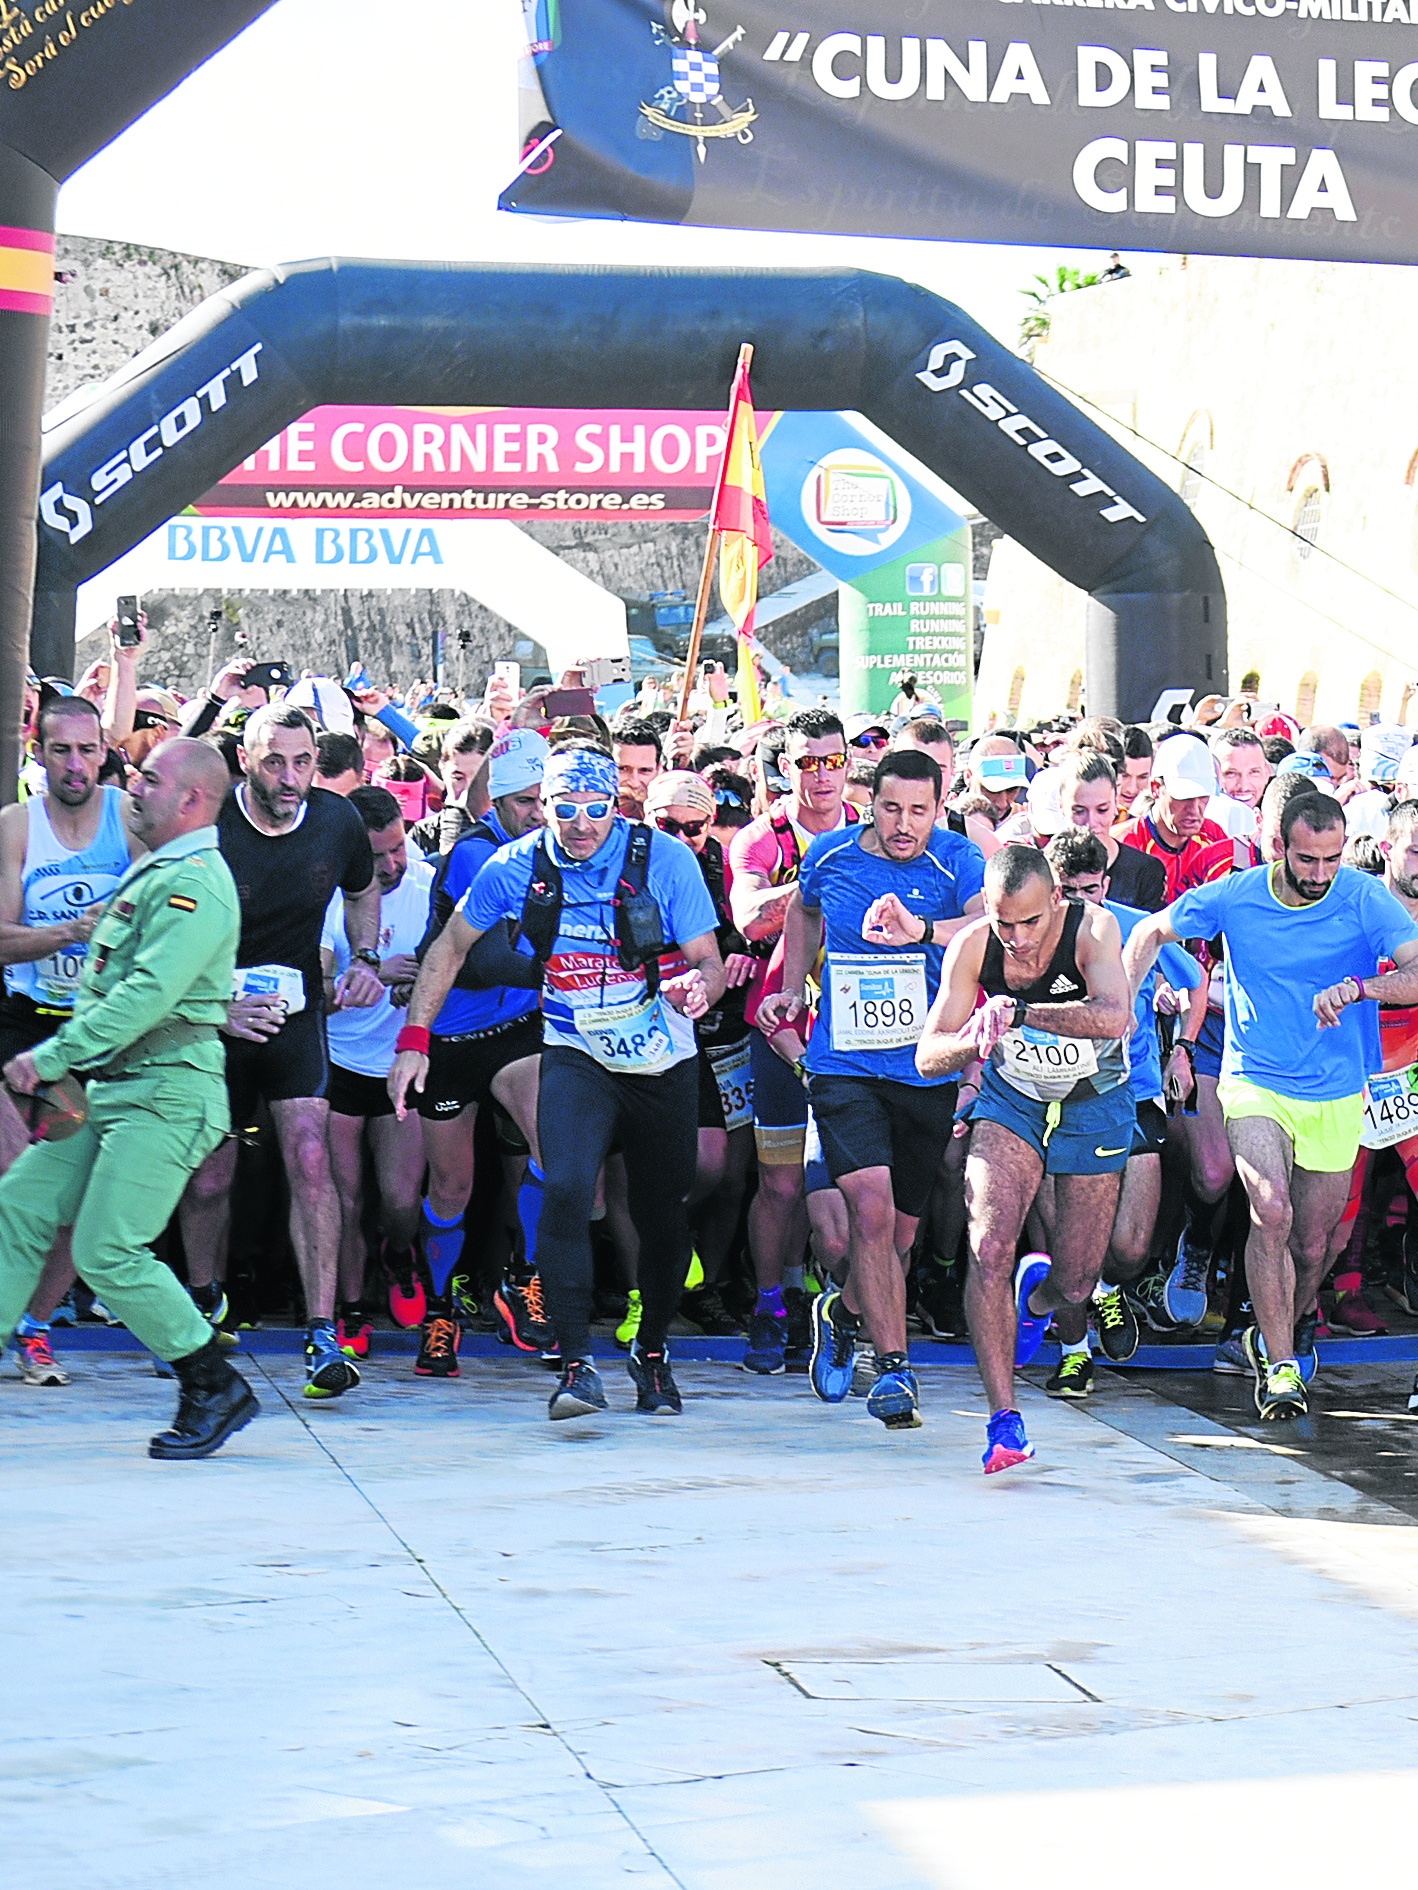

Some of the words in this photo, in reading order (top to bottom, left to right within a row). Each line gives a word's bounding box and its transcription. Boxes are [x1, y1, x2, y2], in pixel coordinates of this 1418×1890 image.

[1077, 44, 1171, 111] DE
[1199, 51, 1293, 117] LA
[1072, 135, 1357, 222] CEUTA
[91, 342, 263, 504] SCOTT
[243, 423, 315, 472] HE
[331, 422, 559, 474] CORNER
[573, 423, 725, 475] SHOP
[959, 382, 1147, 523] SCOTT
[265, 485, 666, 512] www.adventure-store.es
[167, 524, 296, 564] BBVA
[314, 527, 444, 565] BBVA
[867, 602, 906, 616] TRAIL
[909, 602, 966, 616] RUNNING
[909, 619, 966, 633] RUNNING
[906, 636, 966, 650] TREKKING
[855, 652, 967, 670] SUPLEMENTACIÓN
[849, 998, 914, 1028] 1898
[1013, 1039, 1079, 1066] 2100
